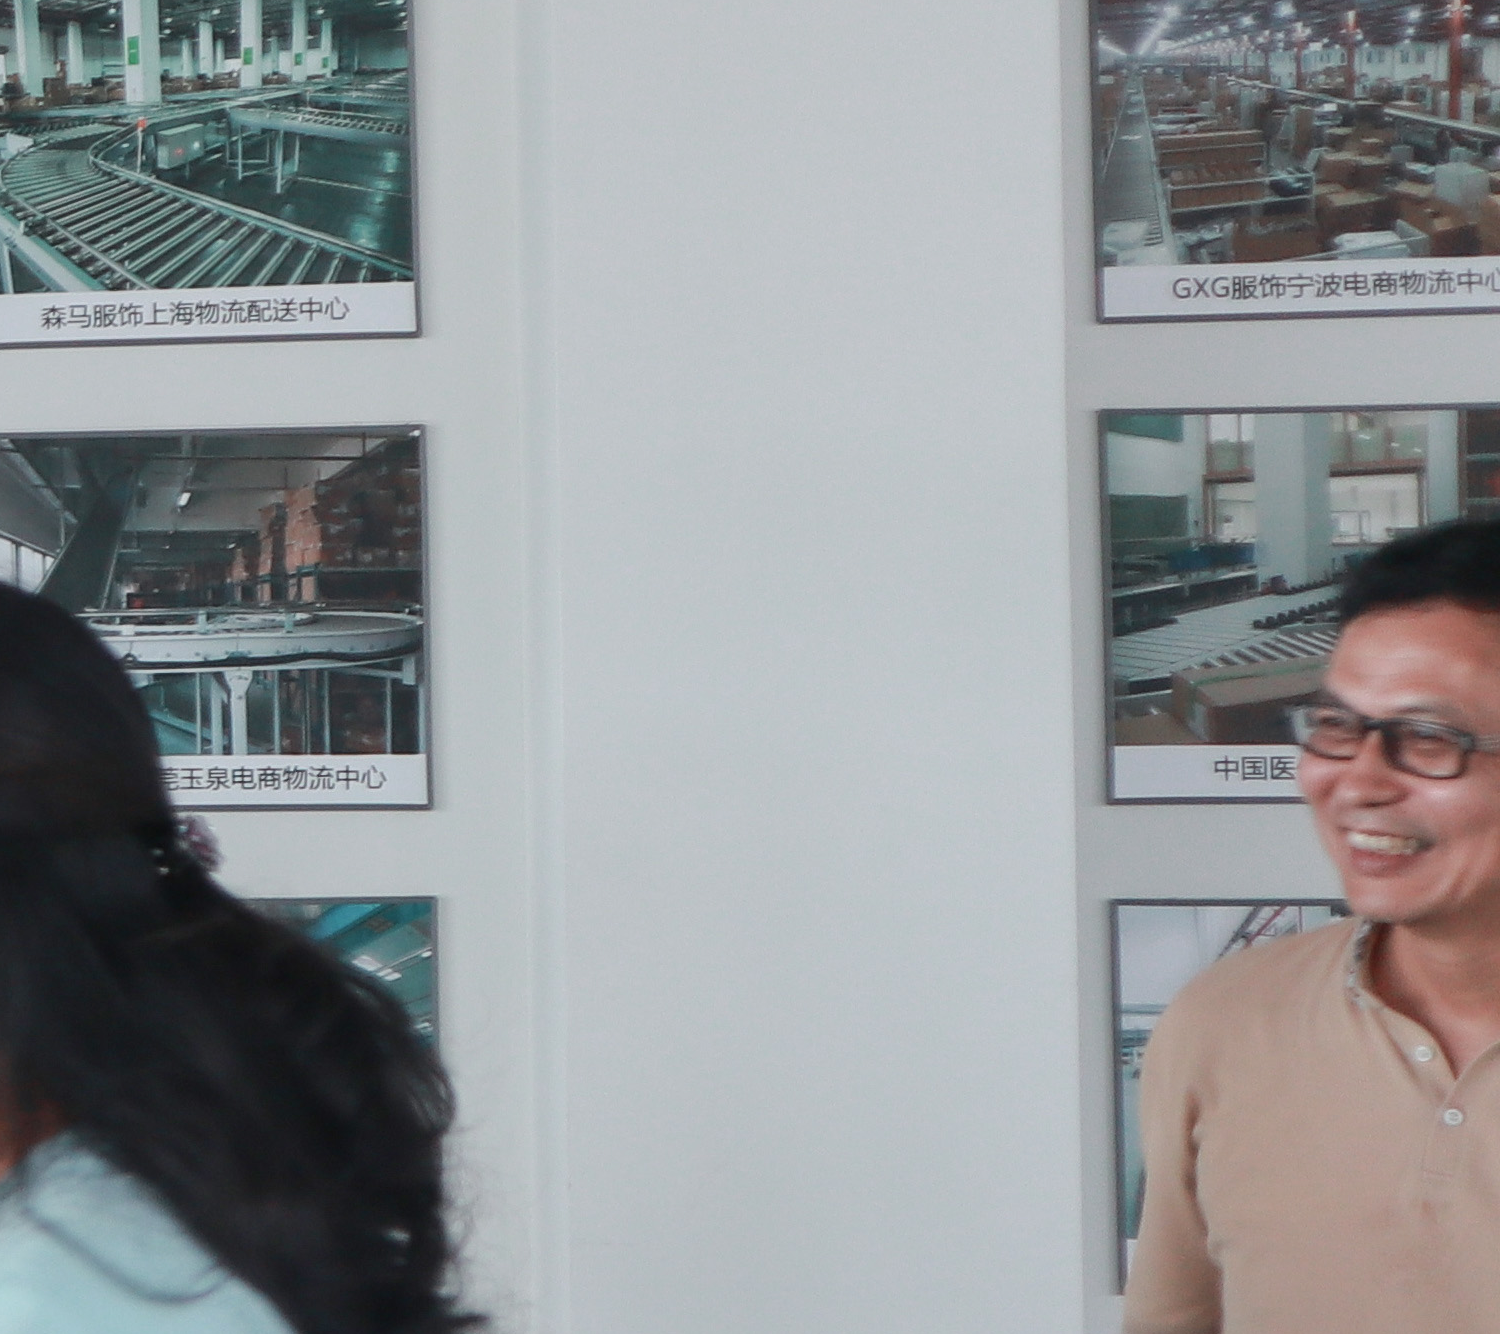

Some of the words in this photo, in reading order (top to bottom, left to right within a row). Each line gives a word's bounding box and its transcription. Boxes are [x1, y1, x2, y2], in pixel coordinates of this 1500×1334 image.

[40, 296, 350, 330] 森马服饰上海物流配送中心
